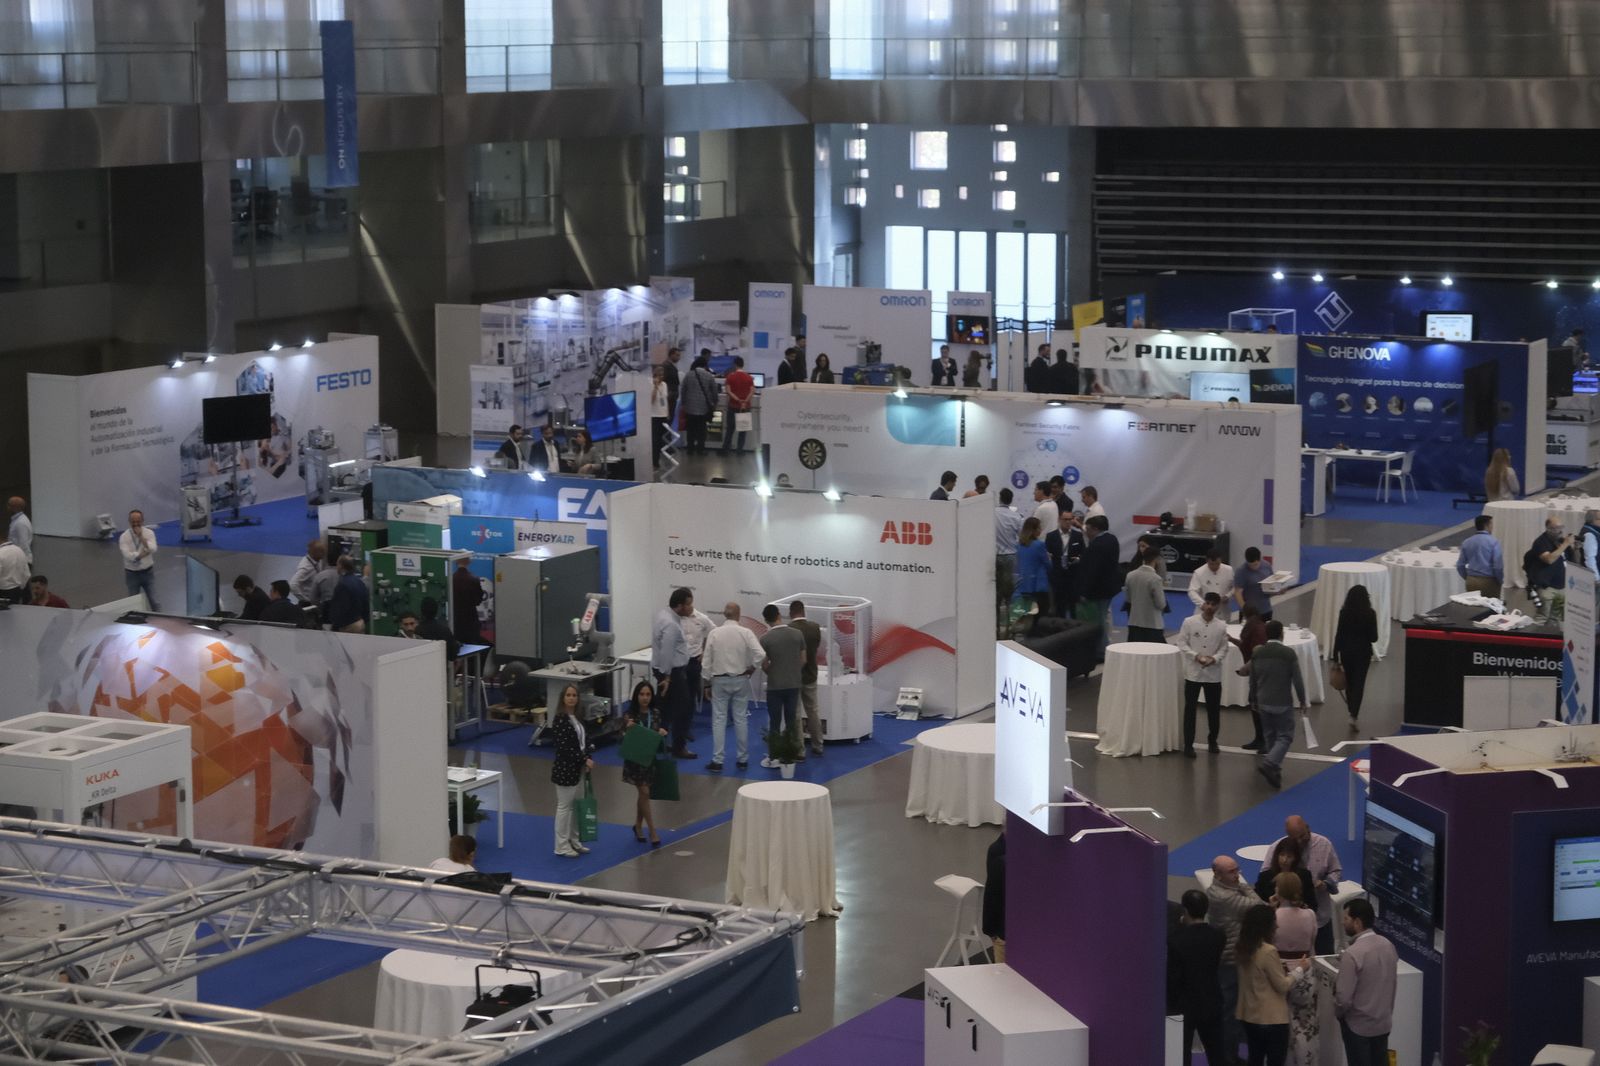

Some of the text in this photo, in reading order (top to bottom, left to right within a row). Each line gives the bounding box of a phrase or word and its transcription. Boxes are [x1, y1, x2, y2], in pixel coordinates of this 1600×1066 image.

[754, 290, 785, 299] OMRON
[880, 295, 926, 307] OMRON
[952, 297, 985, 307] OMRON
[1135, 343, 1272, 363] PNEUMAX
[1328, 345, 1391, 361] GHENOVA
[316, 369, 372, 392] FESTO
[1374, 379, 1391, 389] para
[1393, 379, 1400, 387] la
[1401, 380, 1420, 388] toma
[1422, 381, 1432, 389] de
[1128, 421, 1197, 433] FORTINET
[517, 532, 575, 545] ENERGYAIR
[880, 520, 933, 545] ABB
[668, 546, 935, 574] Let's write the future of robotics and automation.
[669, 560, 717, 574] Together.
[1472, 651, 1564, 671] Bienvenidos
[999, 675, 1046, 728] AVEVA
[85, 768, 120, 785] KUKA
[1526, 952, 1557, 964] AVEVA
